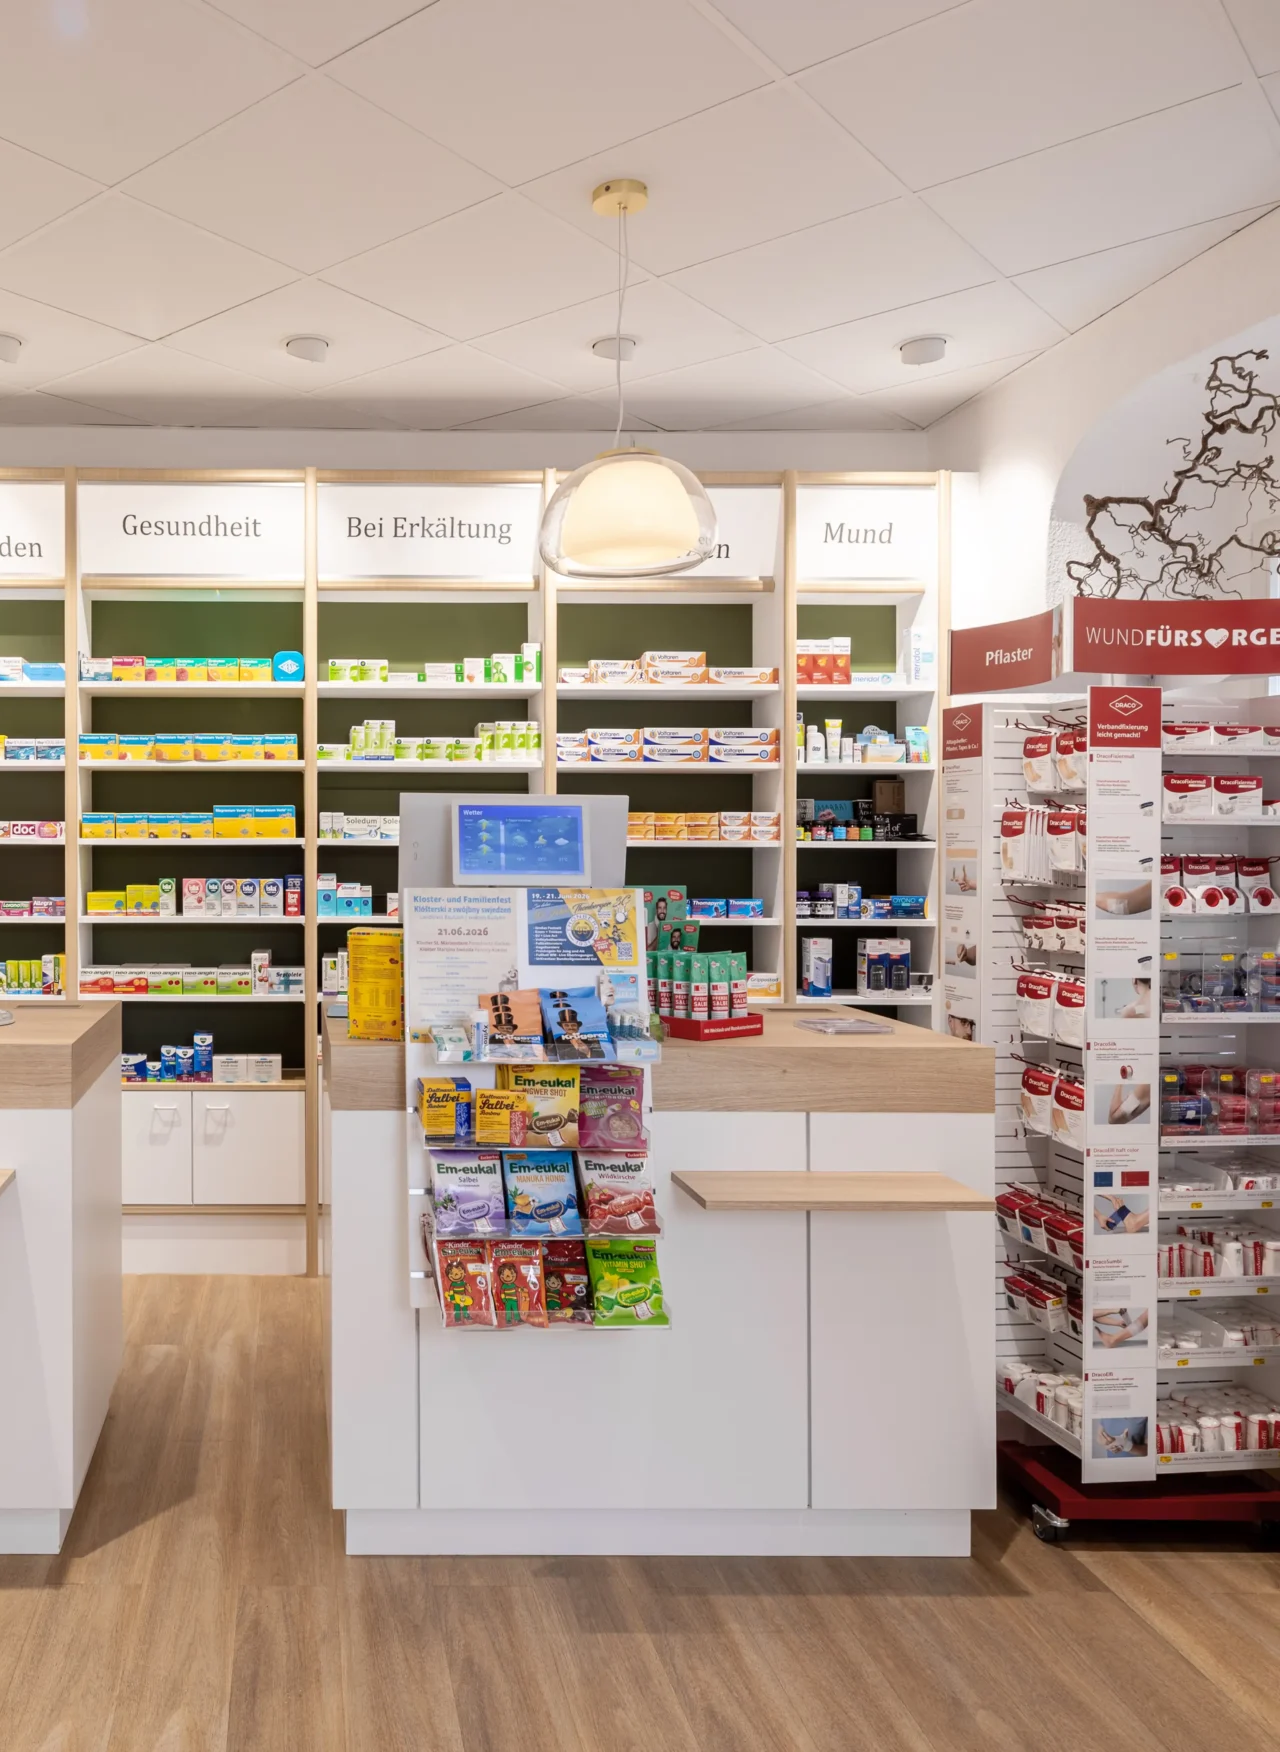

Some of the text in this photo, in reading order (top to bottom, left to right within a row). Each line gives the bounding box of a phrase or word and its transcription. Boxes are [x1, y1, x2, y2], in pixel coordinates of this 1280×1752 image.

[122, 514, 262, 537] Gesundheit
[347, 516, 512, 545] Bei Erkältung
[822, 522, 892, 545] Mund
[985, 646, 1033, 666] Pflaster
[913, 647, 921, 681] meridol
[346, 817, 378, 825] Soledum
[13, 825, 35, 835] doc
[413, 896, 511, 904] Kloster- und Familienfest
[437, 927, 489, 936] 21.06.2026
[1028, 983, 1048, 992] DracoPlast
[1062, 990, 1084, 1000] DracoPlast
[562, 1033, 608, 1041] Krügerol
[514, 1075, 576, 1089] Em-eukal
[1029, 1078, 1049, 1089] DracoPlast
[550, 1088, 567, 1098] SHOT
[580, 1085, 635, 1096] Em-eukal
[436, 1162, 497, 1174] Em-eukal
[509, 1162, 570, 1173] Em-eukal
[584, 1159, 645, 1172] Em-eukal
[458, 1176, 478, 1184] Salbei
[516, 1175, 566, 1184] MANUKA HONIG
[598, 1173, 636, 1181] Wildkirsche
[445, 1241, 470, 1249] Kinder
[592, 1249, 653, 1261] Em-eukal
[603, 1261, 647, 1269] VITAMIN SHOT
